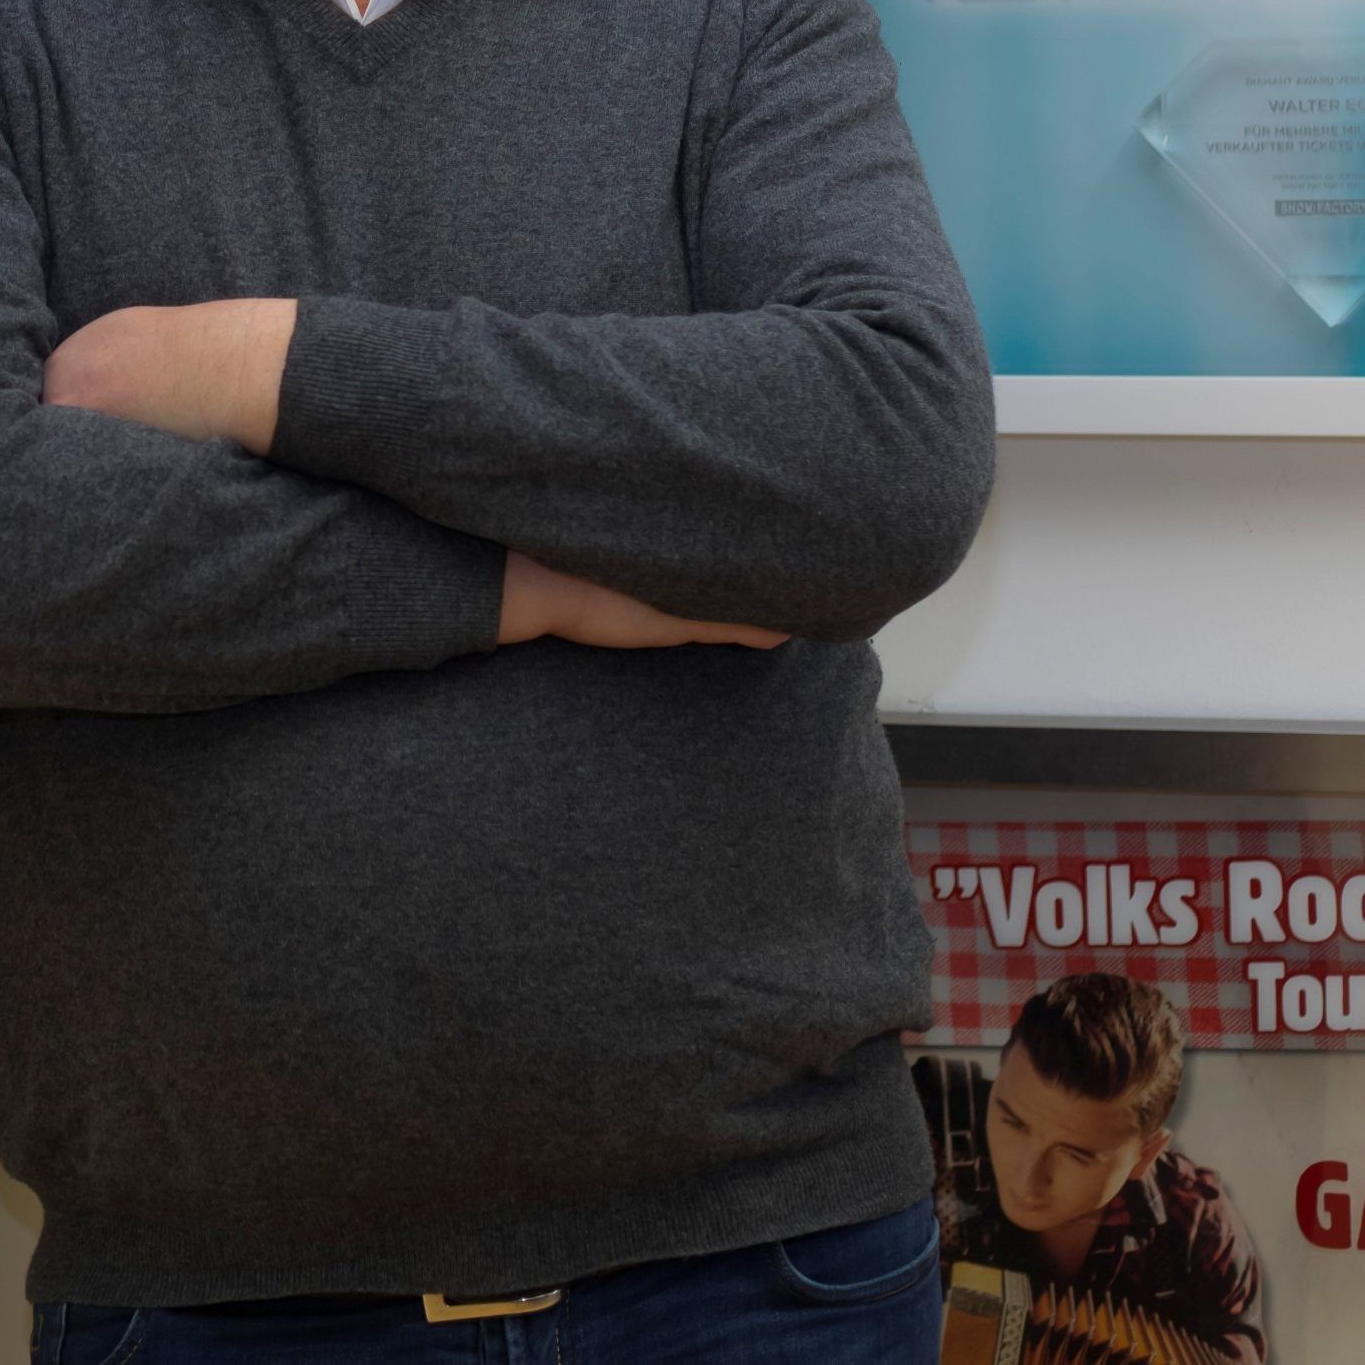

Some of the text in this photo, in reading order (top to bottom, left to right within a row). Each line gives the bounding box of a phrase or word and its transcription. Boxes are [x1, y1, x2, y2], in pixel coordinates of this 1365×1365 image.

[1267, 99, 1340, 113] WALTER
[1298, 140, 1353, 152] TICKETS
[1246, 960, 1365, 1033] Tou
[1294, 1159, 1365, 1251] G
